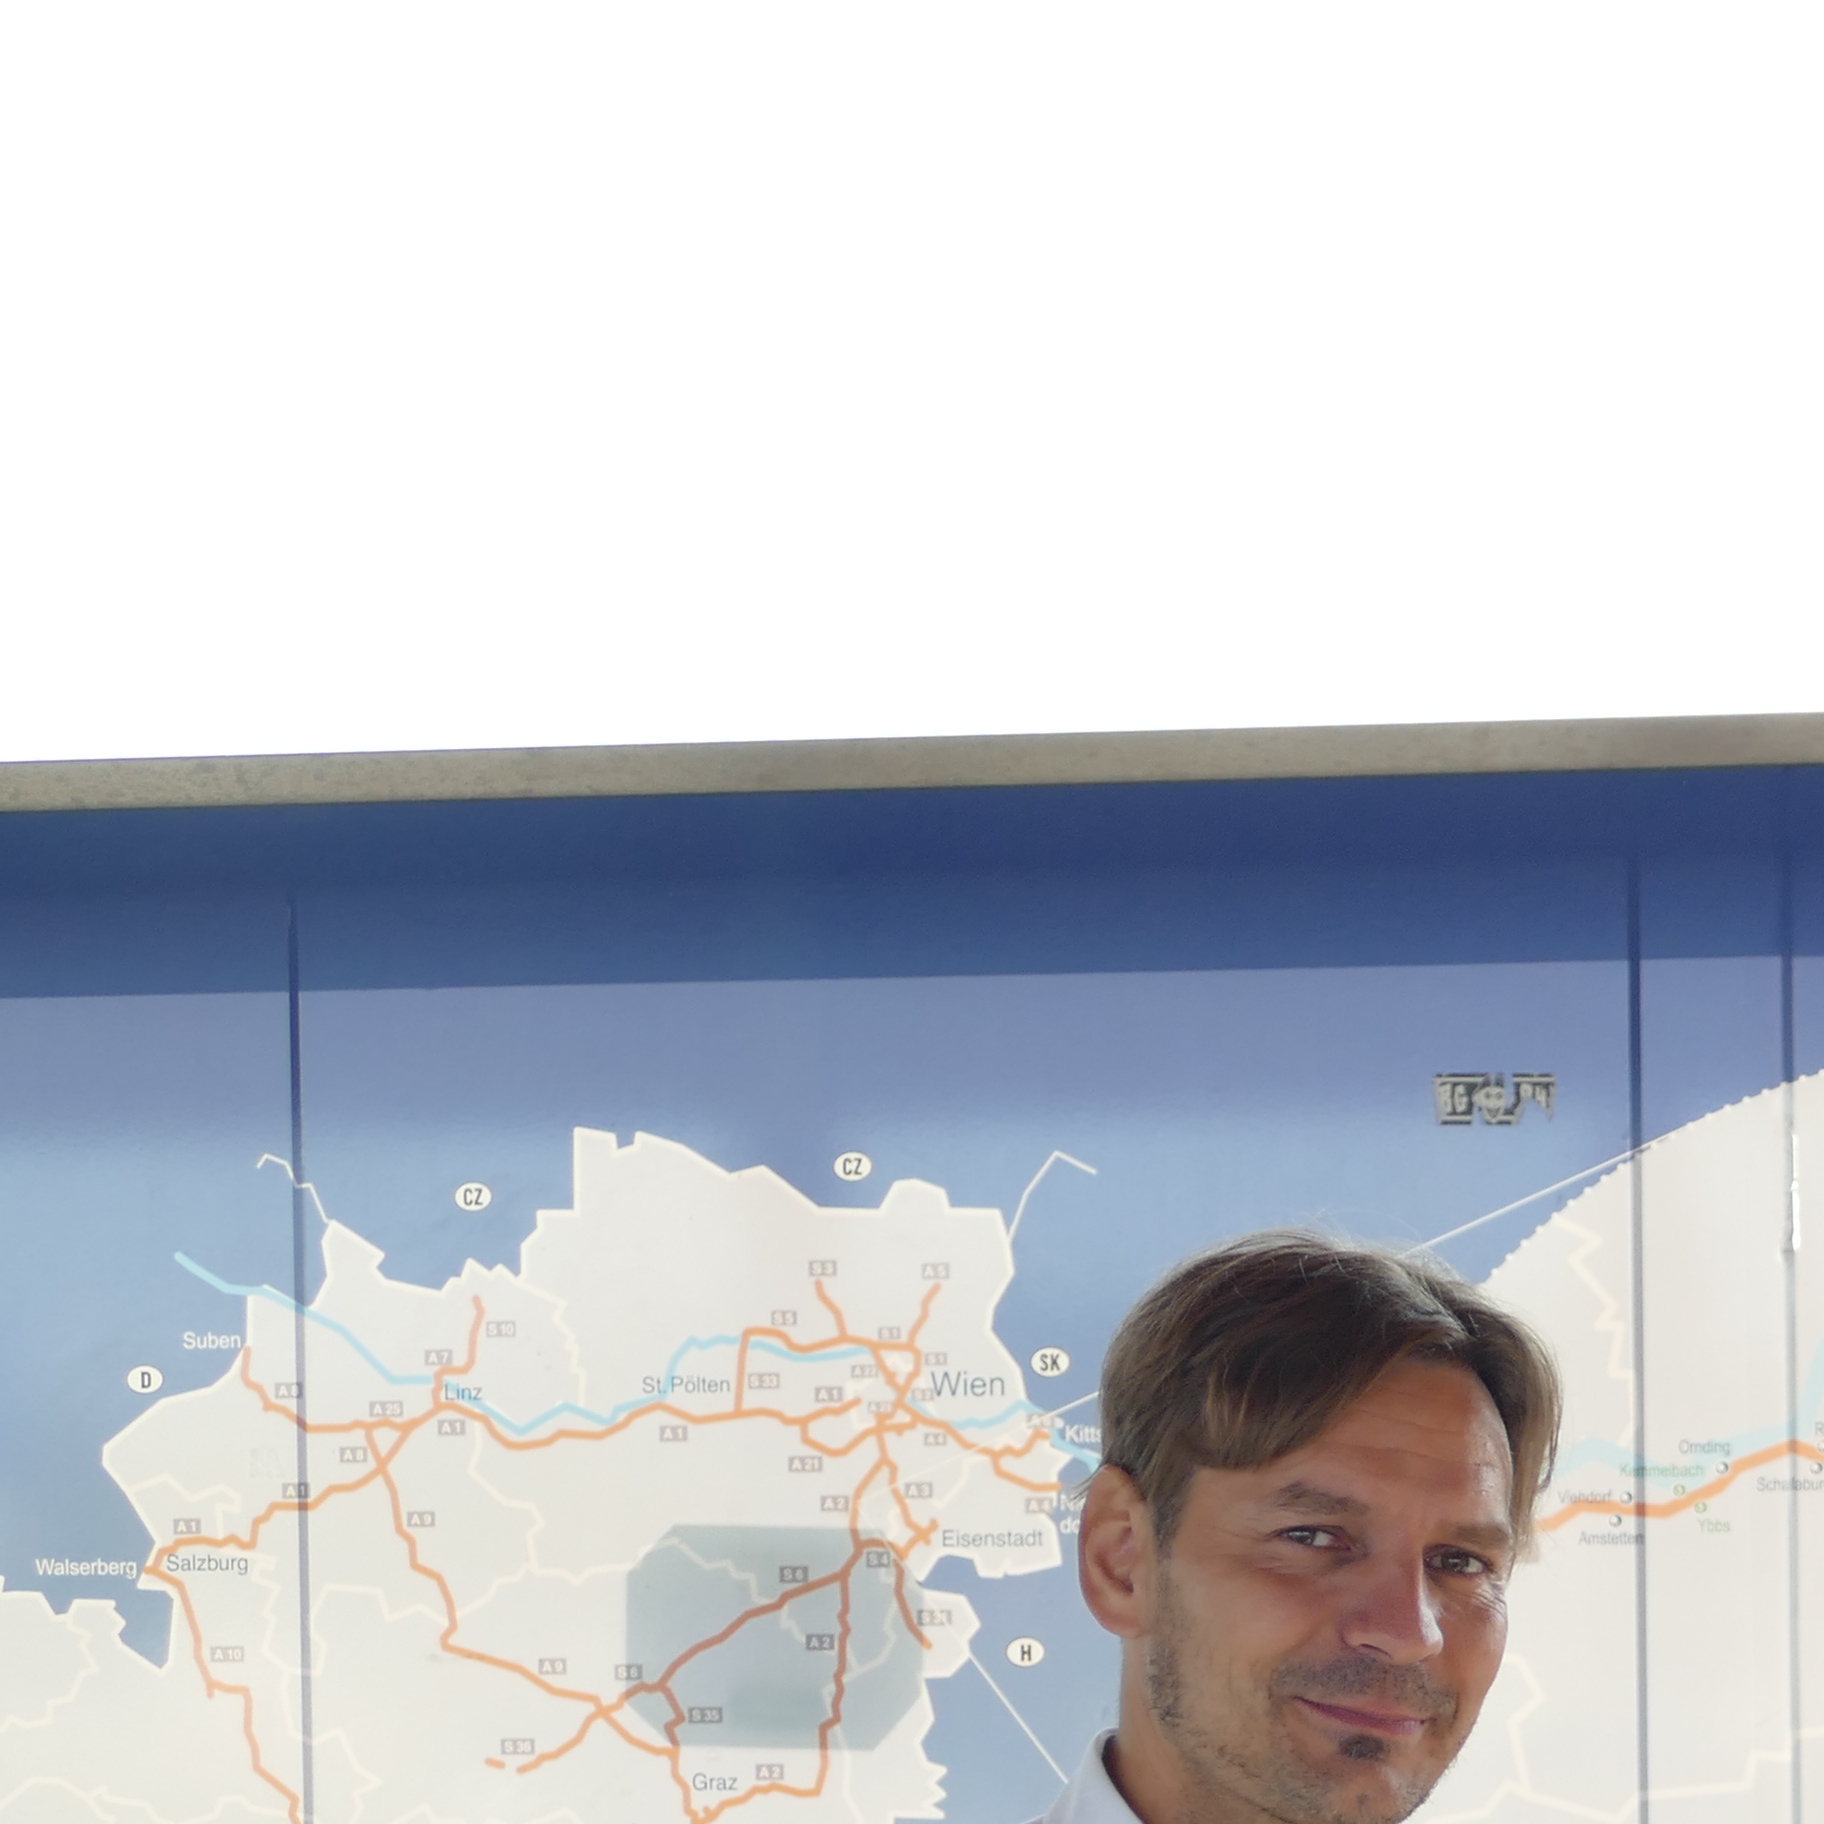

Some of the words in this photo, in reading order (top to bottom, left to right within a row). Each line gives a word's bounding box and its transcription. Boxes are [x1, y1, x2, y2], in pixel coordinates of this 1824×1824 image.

[842, 1157, 863, 1176] CZ
[463, 1187, 484, 1207] CZ
[182, 1331, 242, 1350] Suben
[1040, 1353, 1061, 1372] SK
[140, 1371, 151, 1389] D
[642, 1376, 667, 1394] St.
[671, 1375, 731, 1394] Pölten
[930, 1370, 1006, 1397] Wien
[444, 1383, 483, 1402] Linz
[942, 1528, 1044, 1547] Eisenstadt
[36, 1557, 138, 1580] Walserberg
[166, 1553, 249, 1576] Salzburg
[1020, 1644, 1032, 1662] H
[692, 1772, 739, 1792] Graz
